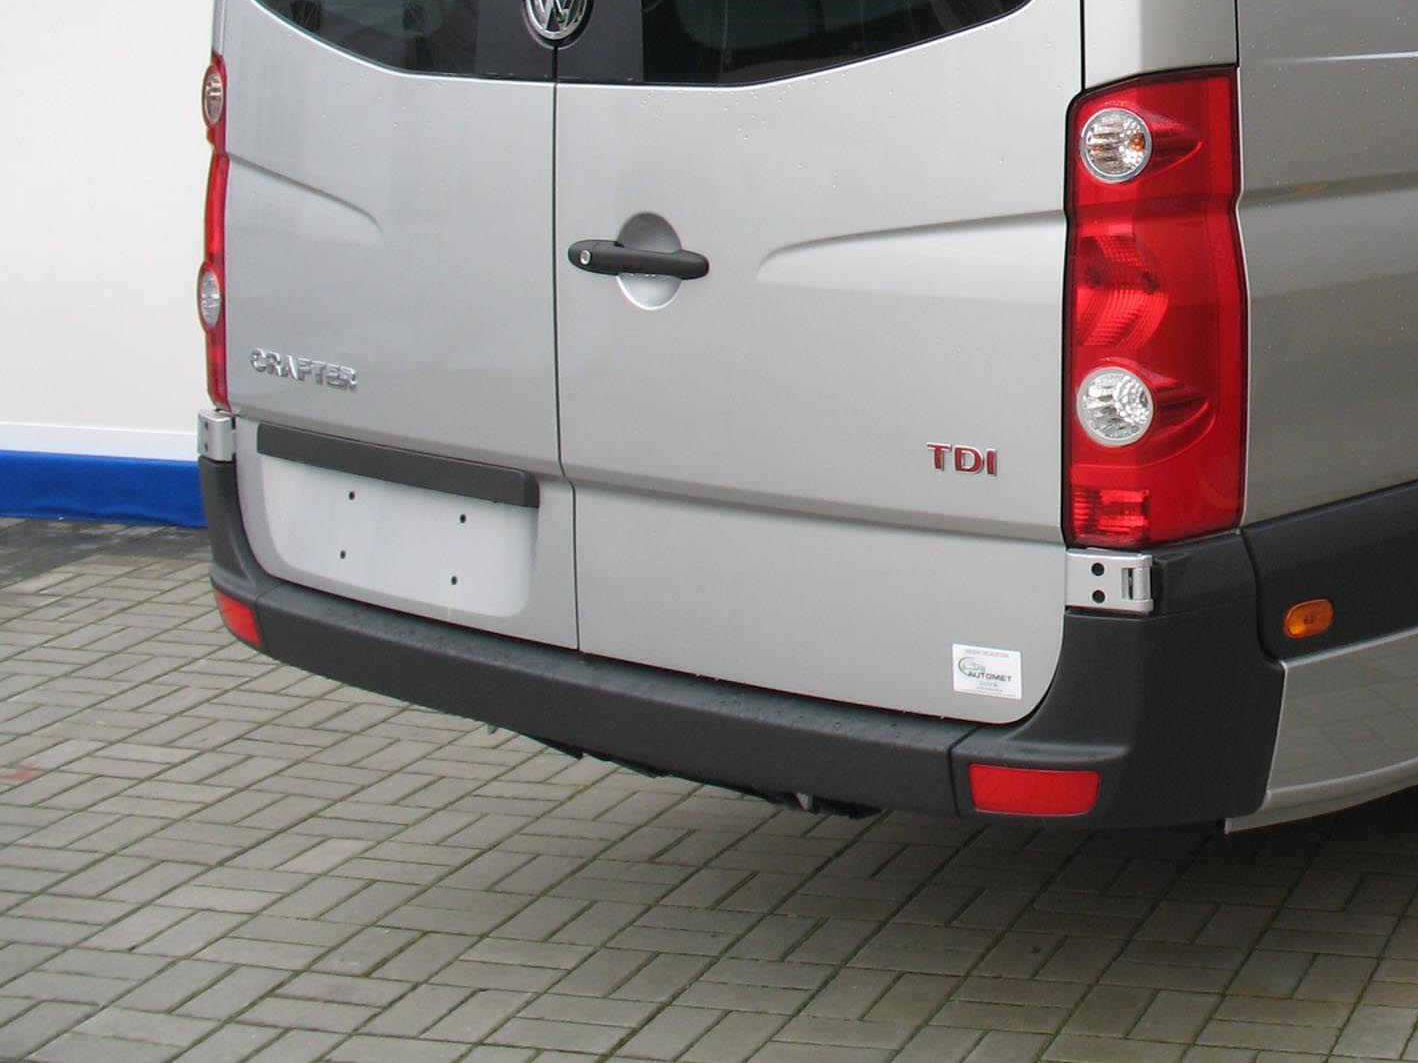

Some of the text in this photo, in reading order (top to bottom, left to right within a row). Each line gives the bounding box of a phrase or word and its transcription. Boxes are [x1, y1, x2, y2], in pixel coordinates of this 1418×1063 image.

[250, 348, 358, 391] CRAFTER
[923, 441, 998, 477] TDI
[967, 671, 1012, 681] AUTOMET
